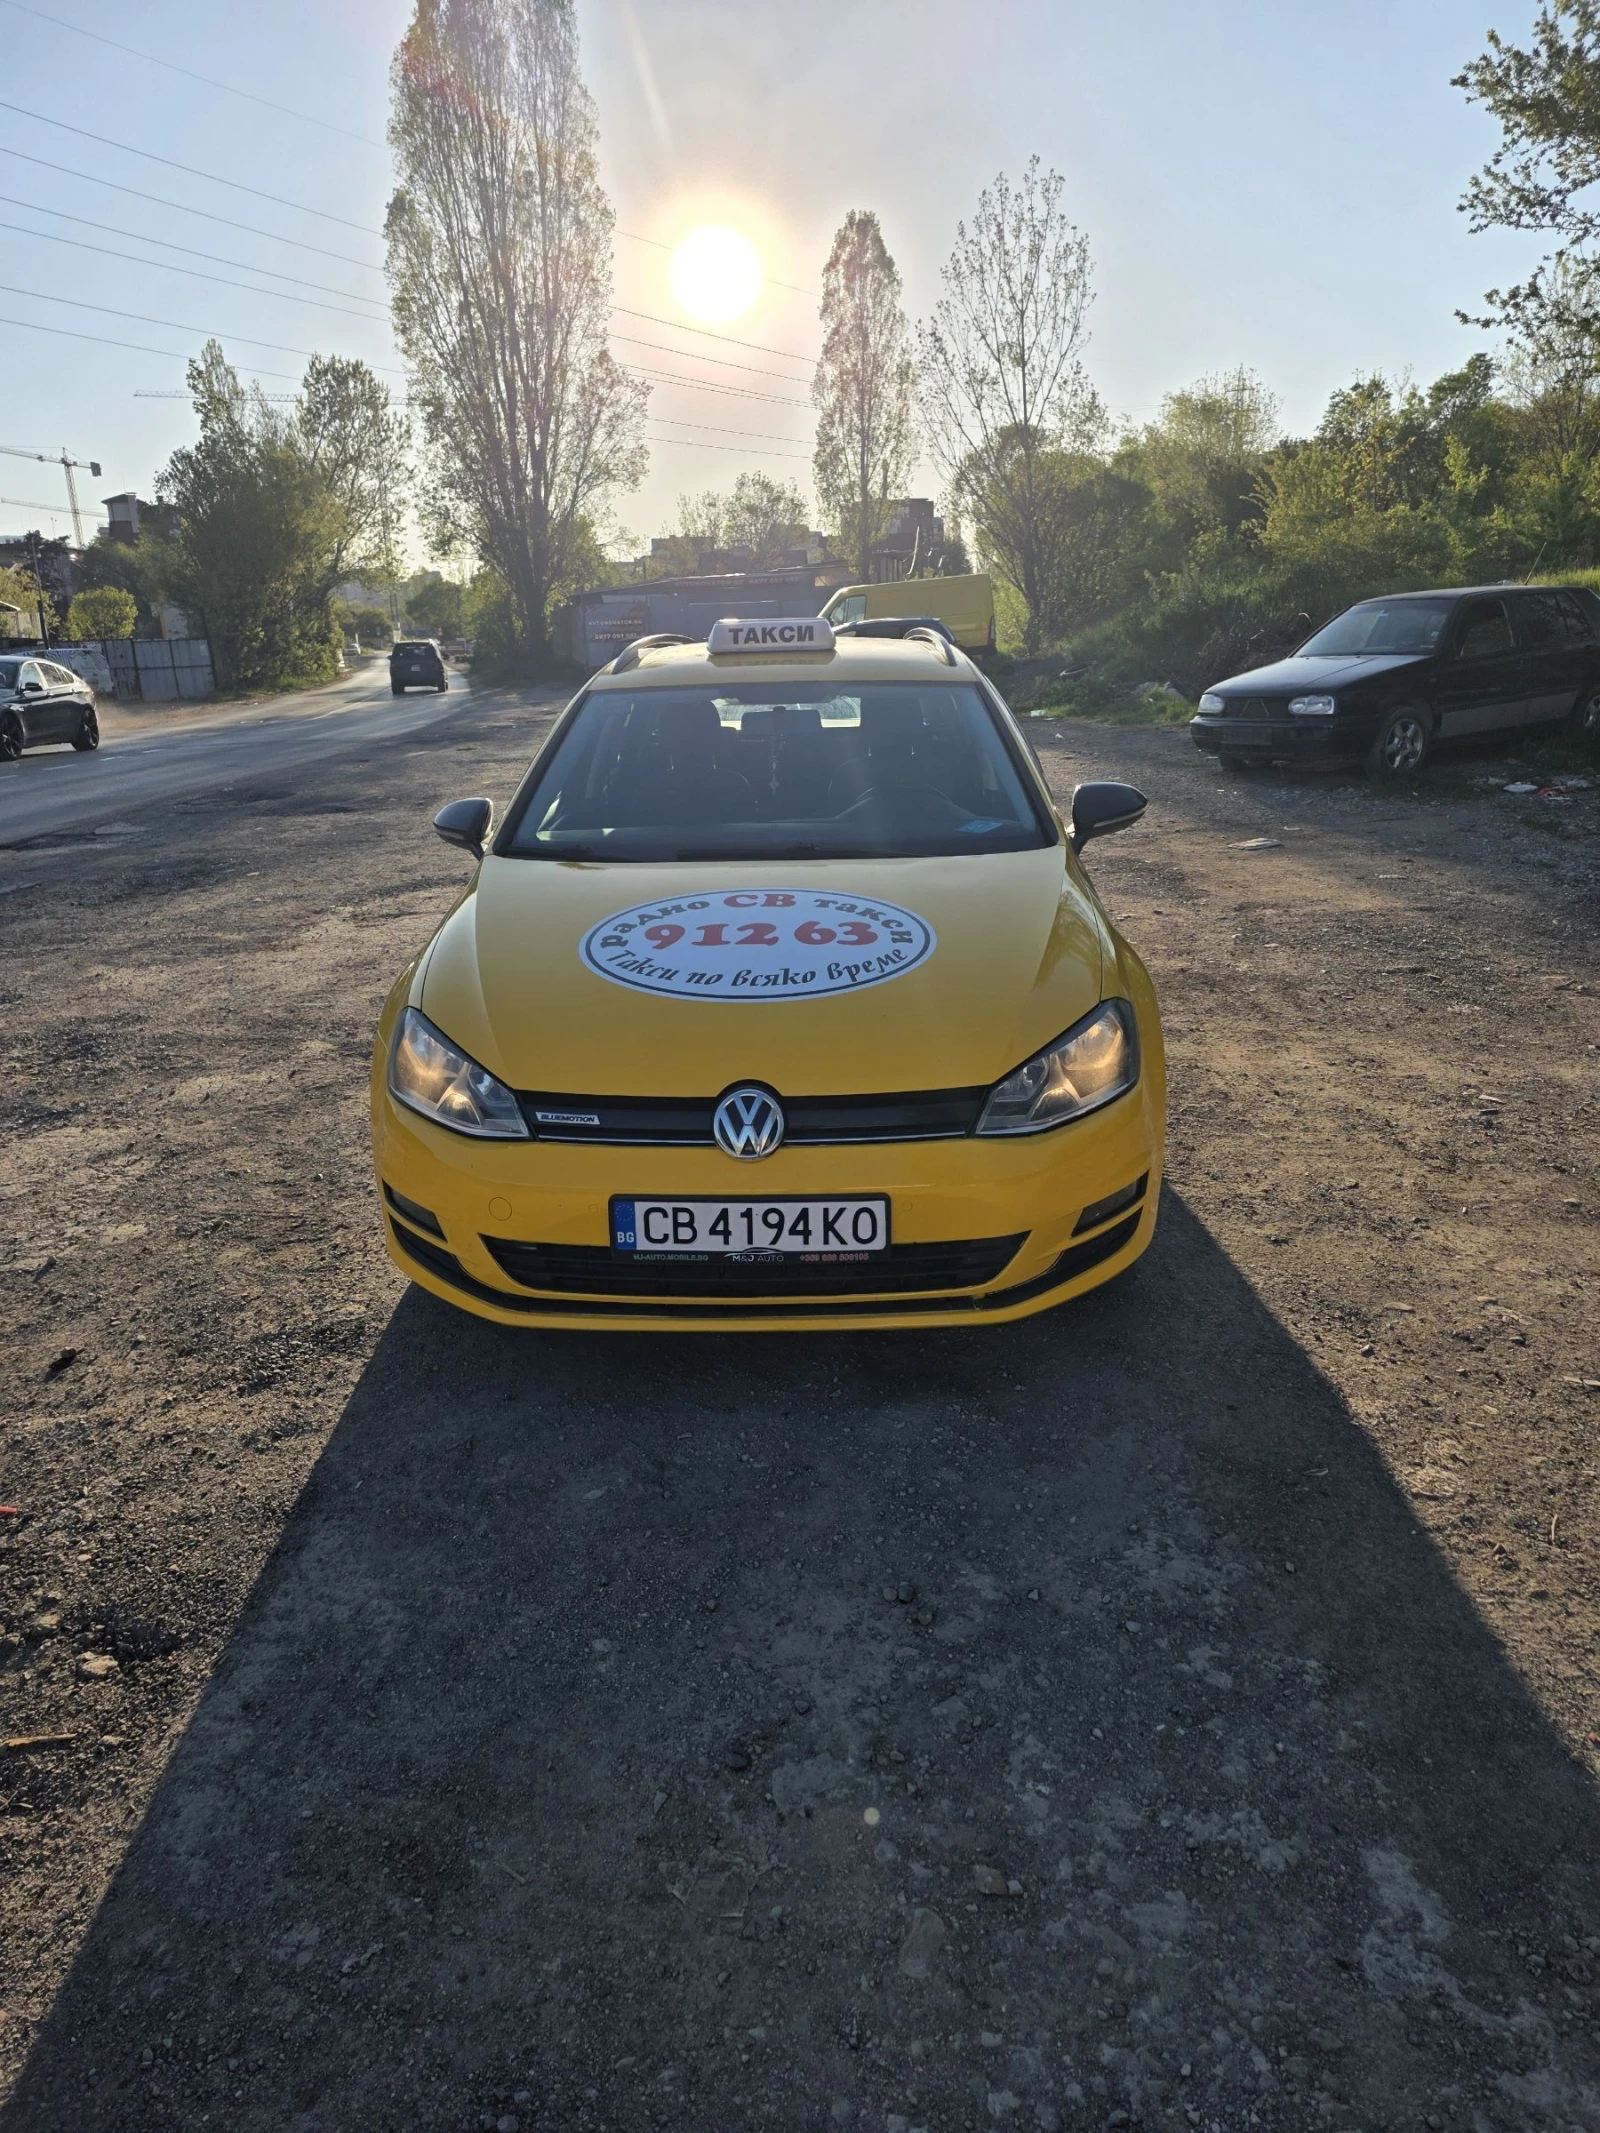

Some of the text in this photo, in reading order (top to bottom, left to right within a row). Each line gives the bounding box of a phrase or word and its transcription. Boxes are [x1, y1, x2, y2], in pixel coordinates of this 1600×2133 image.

[728, 625, 815, 645] ТАКСИ
[606, 950, 680, 981] Такси
[685, 971, 724, 985] по
[541, 1113, 595, 1122] BLUEMOTION
[617, 1231, 635, 1243] BG
[708, 1207, 812, 1246] 4194
[732, 1254, 785, 1262] M&J AUTO
